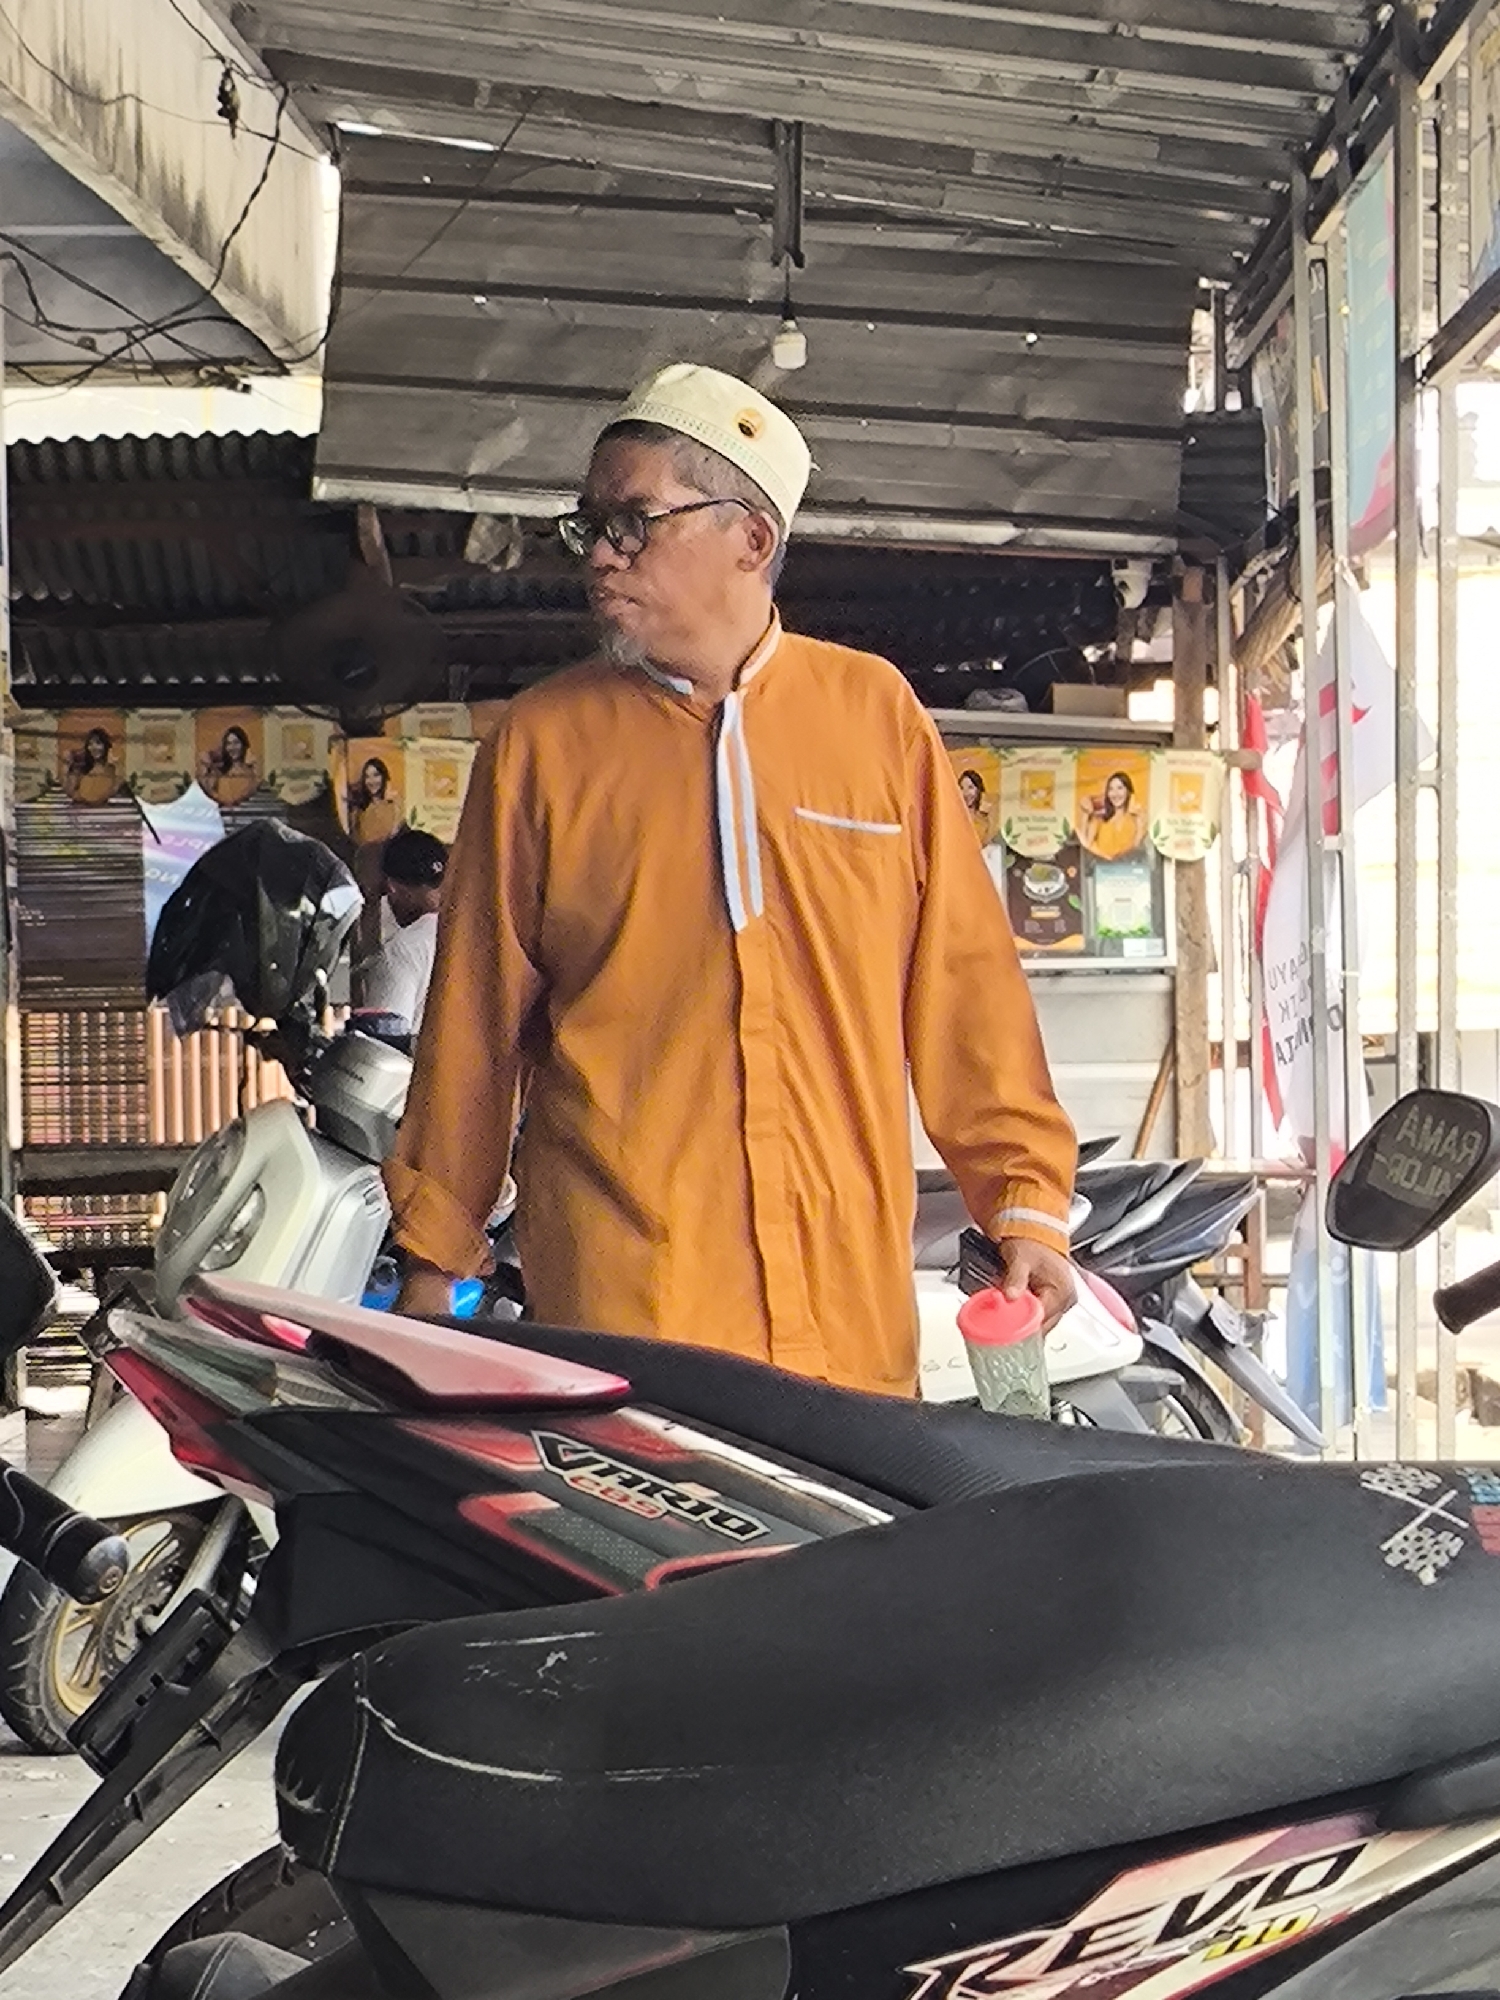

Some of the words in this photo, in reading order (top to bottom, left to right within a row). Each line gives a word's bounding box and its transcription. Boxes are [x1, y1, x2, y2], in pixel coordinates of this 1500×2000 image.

[536, 1433, 766, 1539] VARIO
[569, 1475, 659, 1515] CBS
[903, 1838, 1370, 2000] REVO
